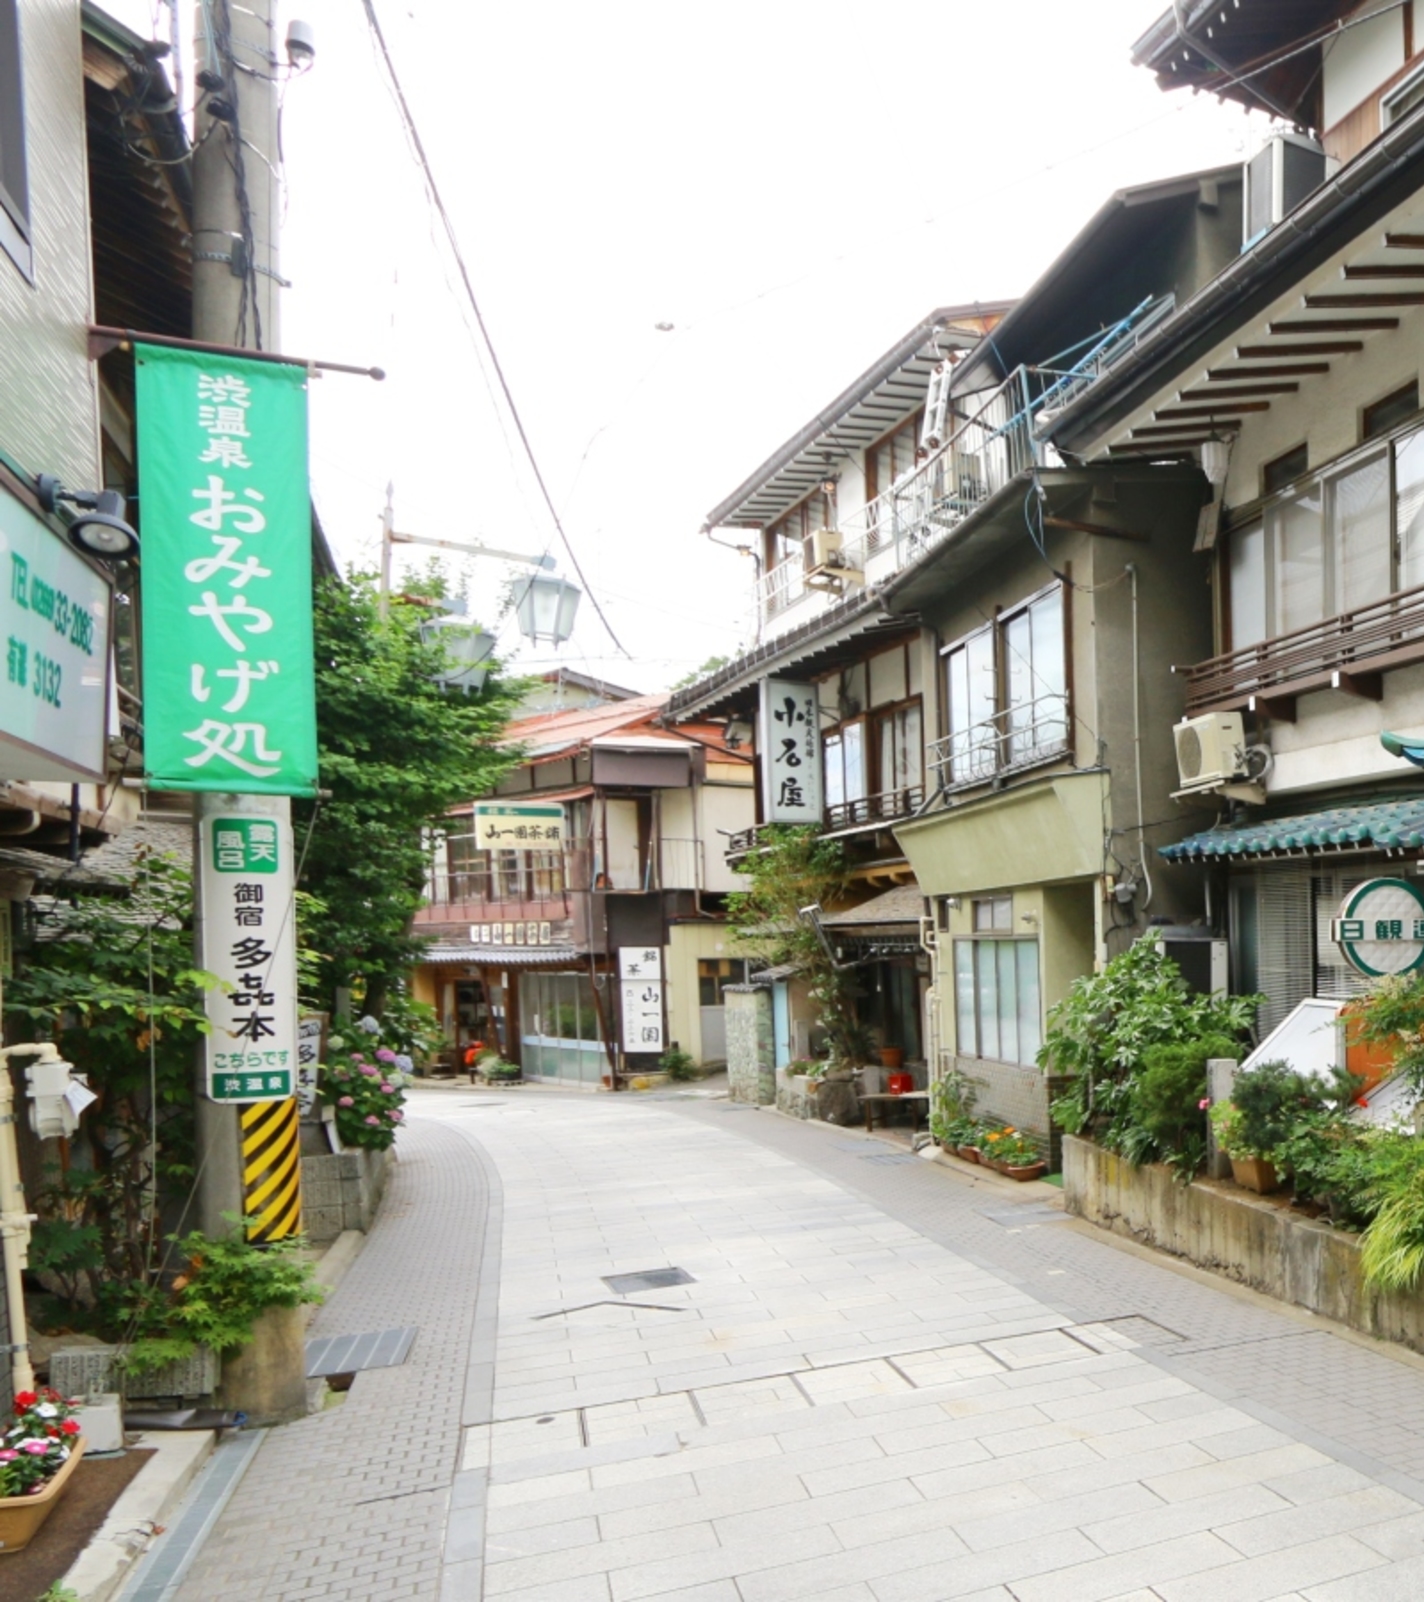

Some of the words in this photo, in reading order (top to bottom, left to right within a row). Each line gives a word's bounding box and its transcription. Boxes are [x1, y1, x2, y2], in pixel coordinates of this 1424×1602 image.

[197, 373, 253, 469] 渋温泉
[11, 550, 29, 610] TEL
[182, 475, 282, 778] おみやげ処
[34, 651, 61, 709] 3132
[213, 1050, 290, 1069] こちらです
